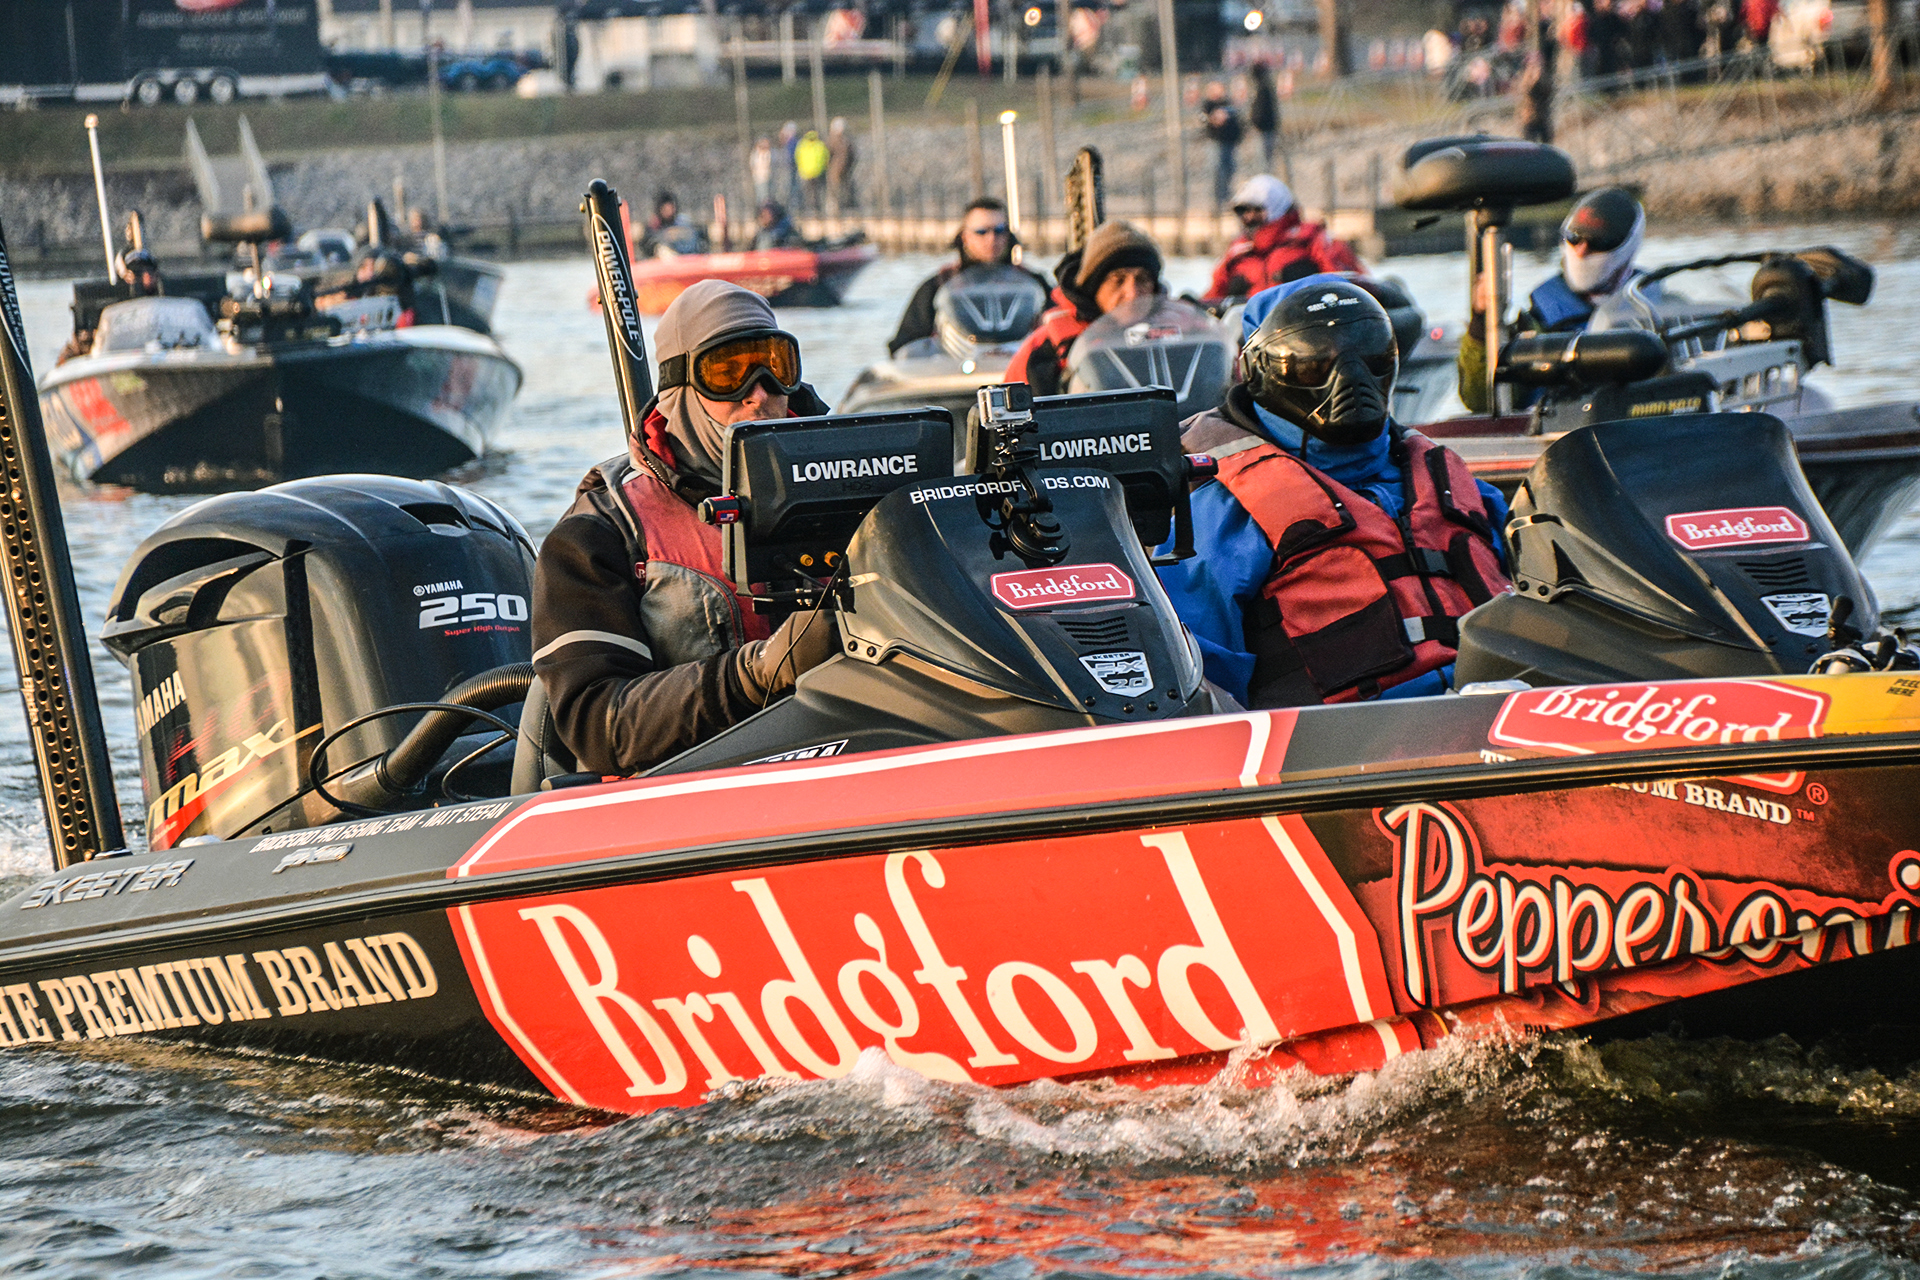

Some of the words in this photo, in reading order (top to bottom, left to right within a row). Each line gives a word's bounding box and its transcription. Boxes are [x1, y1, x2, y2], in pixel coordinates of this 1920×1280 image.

[598, 230, 640, 341] POWER-POLE
[1039, 432, 1152, 462] LOWRANCE
[792, 454, 919, 483] LOWRANCE
[910, 475, 1111, 504] BRIDGFORDFDS.COM
[1682, 515, 1796, 540] Bridgford
[424, 580, 464, 594] YAMAHA
[1005, 571, 1122, 601] Bridgford
[419, 593, 529, 630] 250
[444, 627, 472, 637] Super
[473, 624, 494, 633] High
[495, 624, 521, 633] Output
[1107, 677, 1149, 691] 20
[136, 670, 187, 741] AMAHA
[1530, 685, 1793, 744] Bridgford
[1685, 782, 1793, 825] BRAND
[249, 829, 323, 854] BRIDGFORD
[311, 826, 342, 844] PRO
[334, 819, 387, 842] FISHING
[382, 813, 423, 835] TEAM
[421, 807, 469, 829] MATT
[456, 801, 514, 824] STEFAN
[20, 858, 196, 910] SKEETER
[518, 831, 1283, 1097] Bridgford
[37, 953, 272, 1042] PREMIUM
[252, 932, 439, 1017] BRAND
